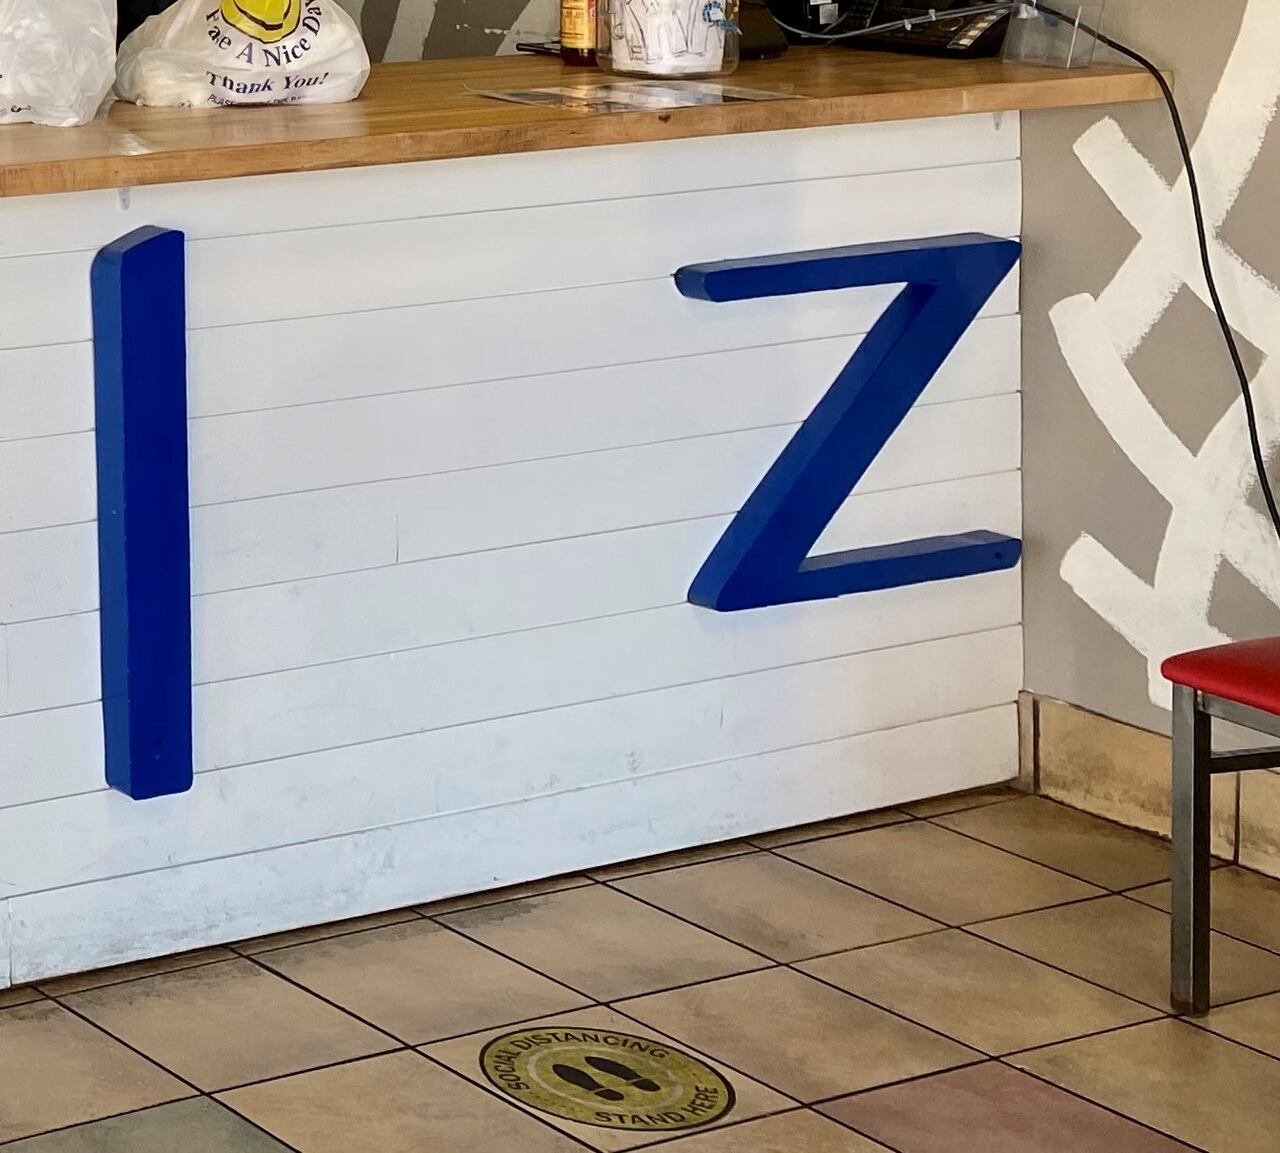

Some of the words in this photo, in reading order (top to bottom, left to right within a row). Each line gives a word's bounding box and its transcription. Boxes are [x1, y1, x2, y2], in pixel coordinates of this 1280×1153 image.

[236, 41, 254, 65] A
[263, 37, 311, 67] Nice
[205, 70, 276, 95] Thank
[283, 72, 329, 90] You!
[510, 1032, 669, 1060] DISTANCING
[493, 1049, 530, 1091] SOCIAL
[594, 1111, 686, 1126] STAND
[681, 1085, 719, 1117] HERE
